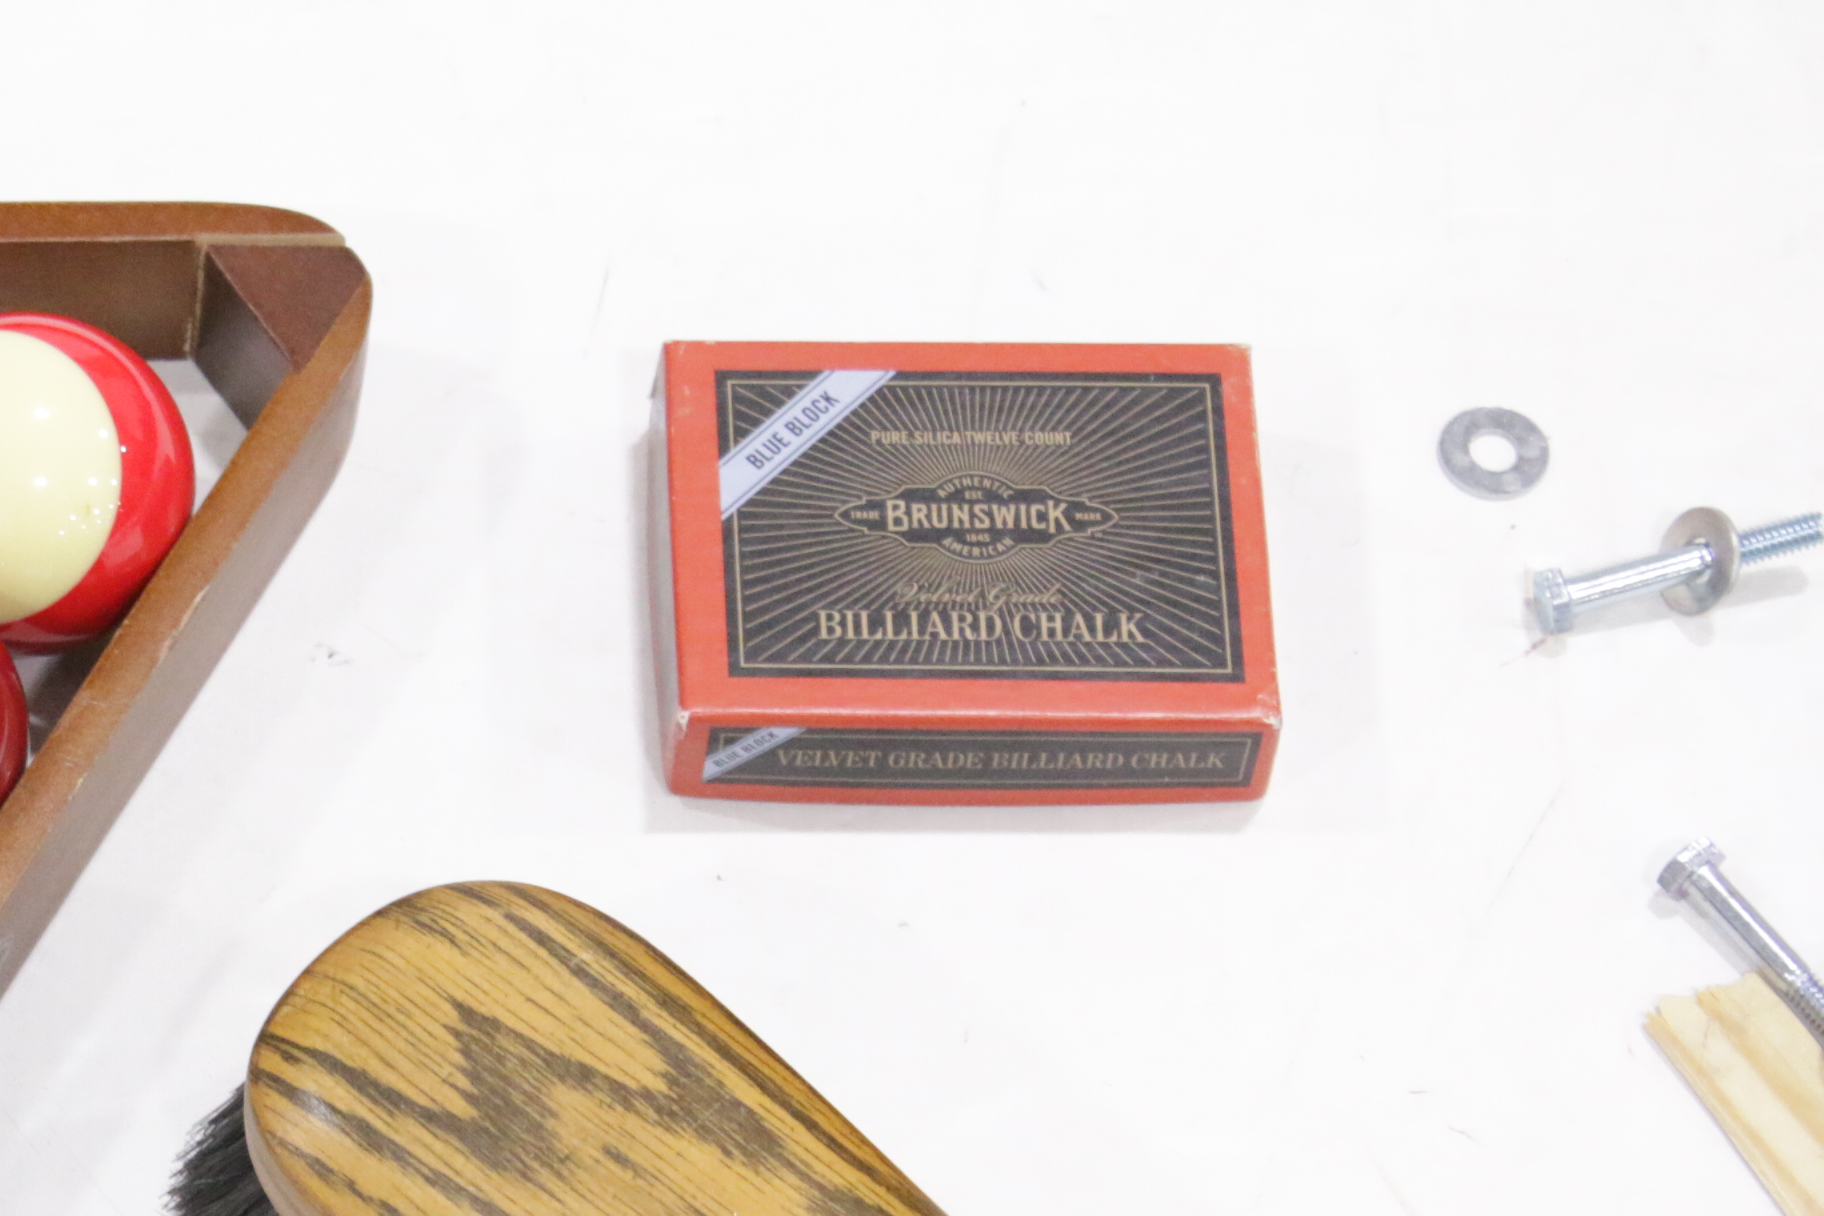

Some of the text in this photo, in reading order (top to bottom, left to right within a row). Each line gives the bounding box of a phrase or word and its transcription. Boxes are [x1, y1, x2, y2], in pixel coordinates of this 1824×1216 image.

[745, 389, 842, 471] BLUE BLOCK
[871, 431, 1072, 446] PURE SILICA TWELVE COUNT
[936, 475, 1016, 499] AUTHENTIC
[886, 499, 1073, 534] BRUNSWICK
[940, 536, 1016, 558] AMERICAN
[816, 609, 1150, 643] BILLIARD CHALK
[776, 749, 1226, 770] VELVET GRADE BILLIARD CHALK
